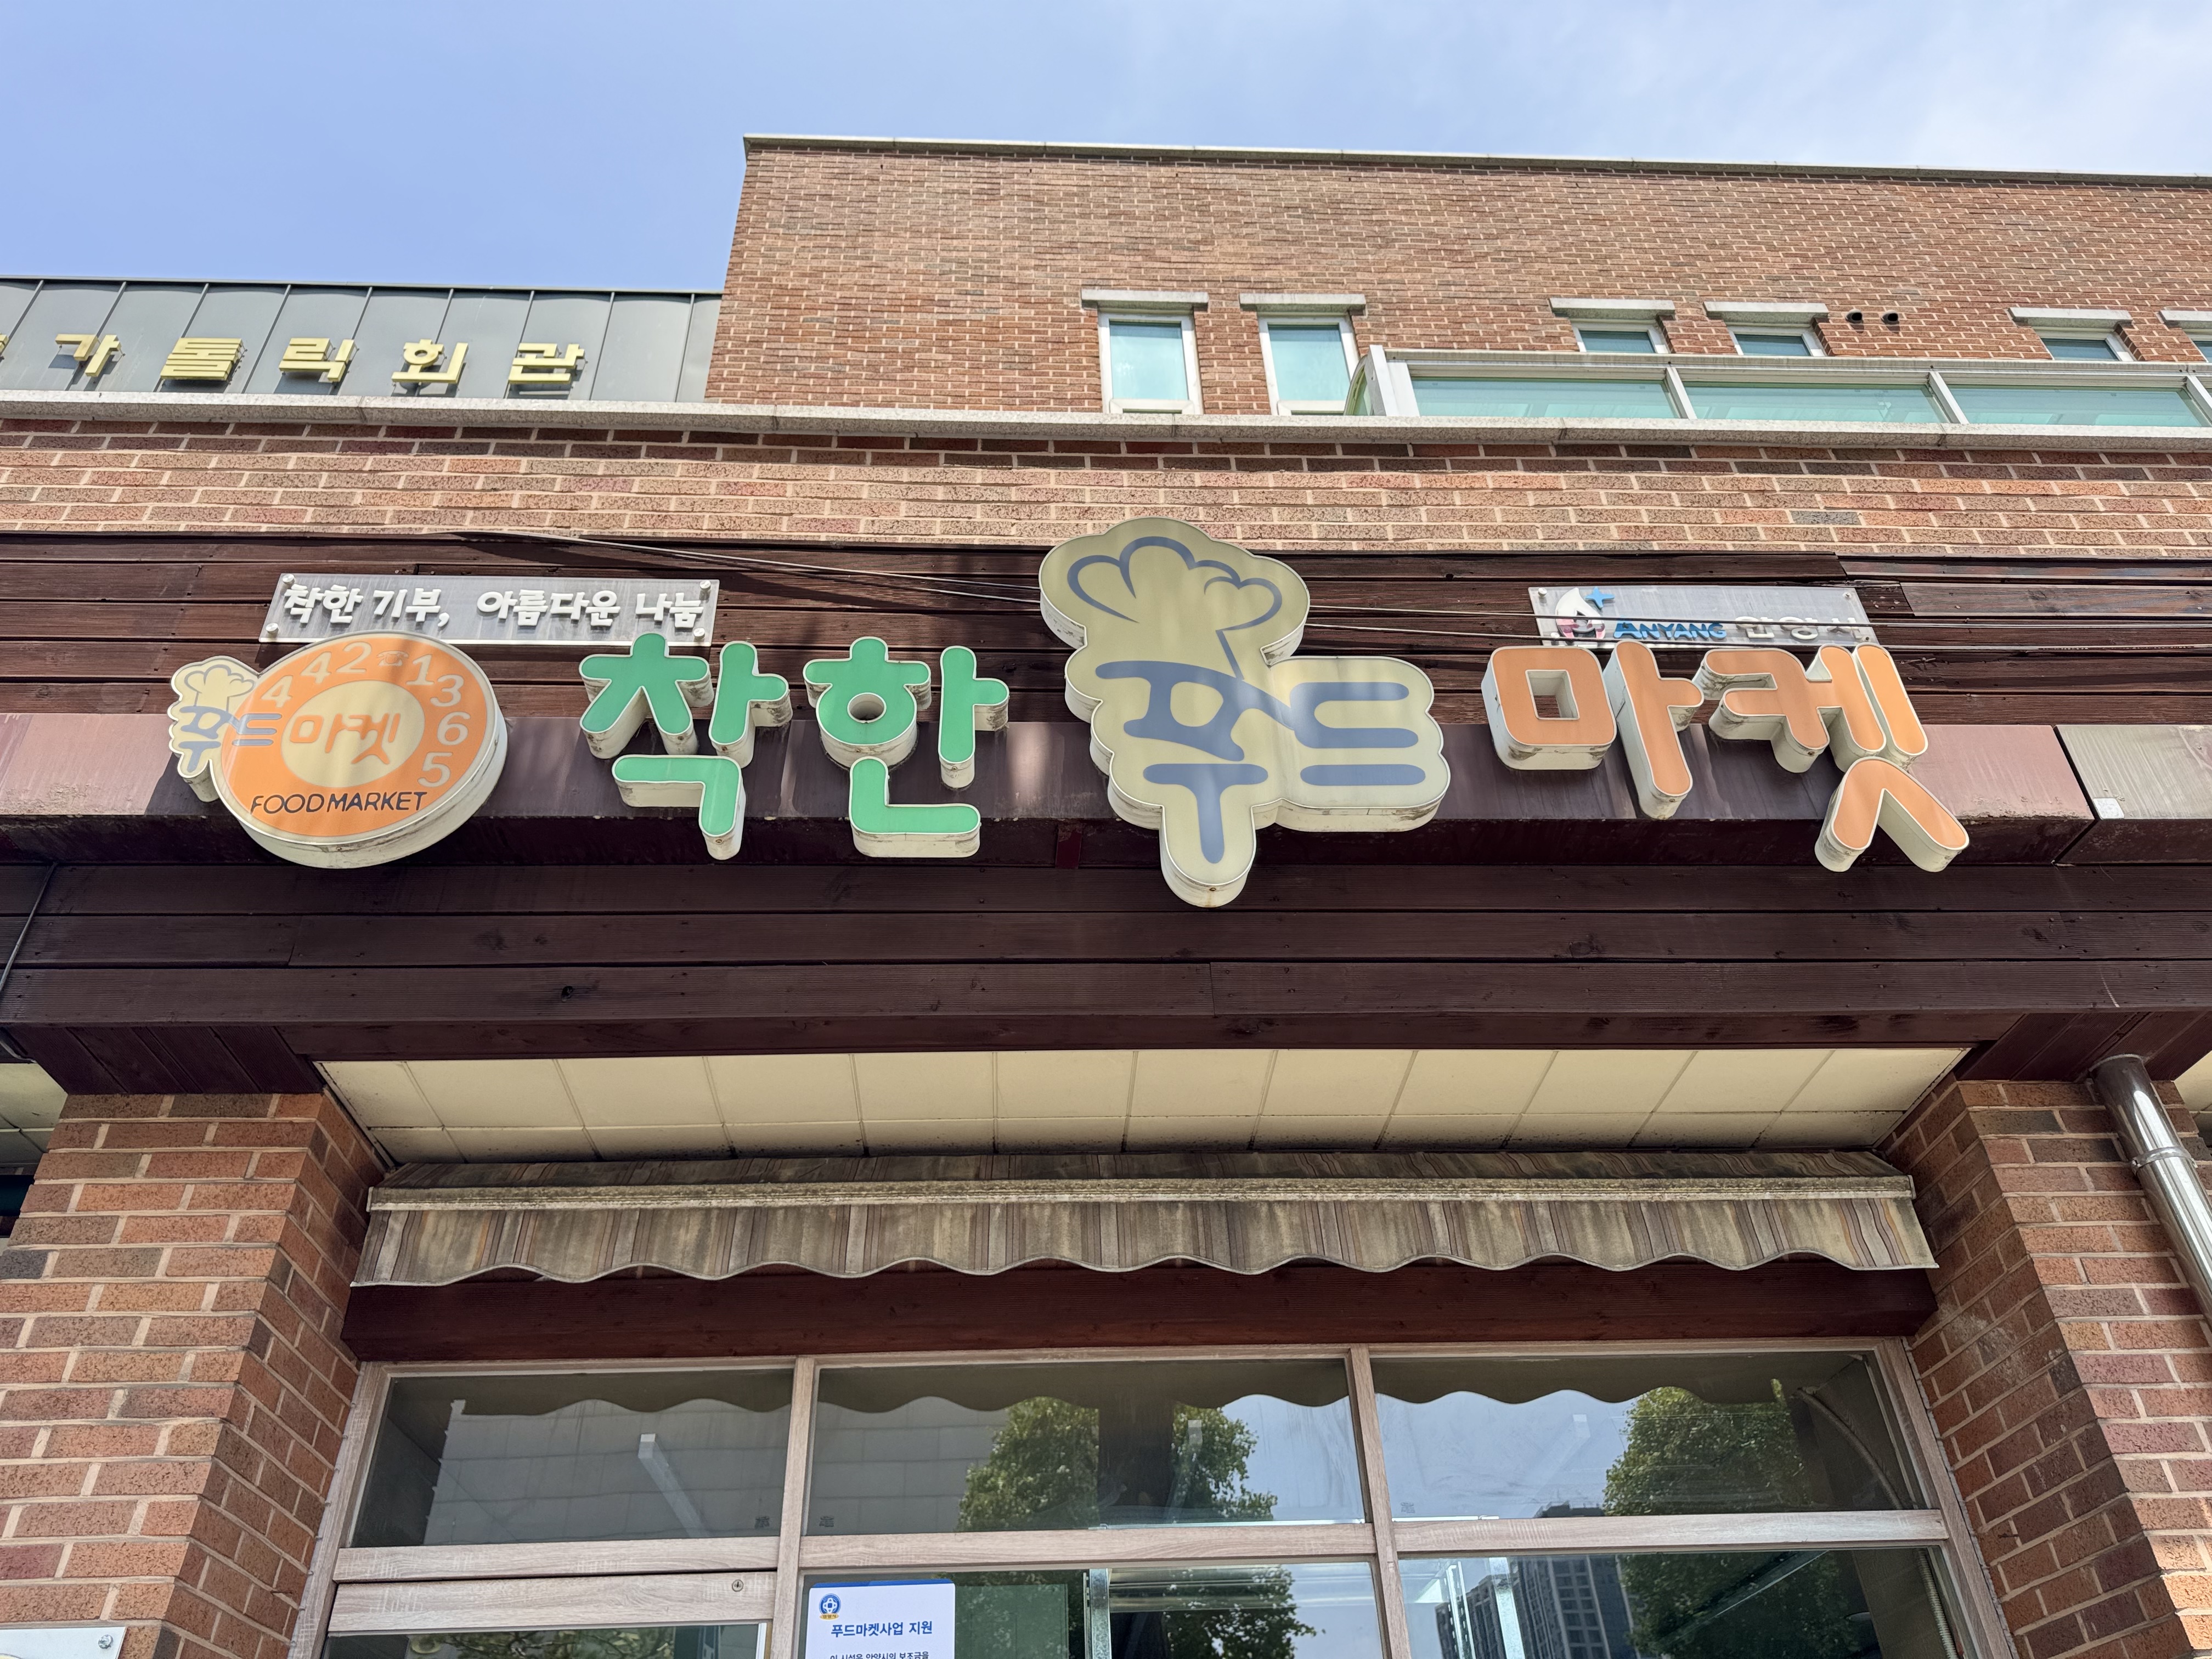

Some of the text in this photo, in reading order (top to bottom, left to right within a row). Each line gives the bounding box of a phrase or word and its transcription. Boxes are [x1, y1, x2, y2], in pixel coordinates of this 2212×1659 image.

[284, 584, 704, 629] 착한 기부, 아름다운 나눔
[1613, 619, 1728, 641] ANYANG
[1735, 616, 1863, 640] 안양시
[579, 633, 1011, 849] 착한
[831, 1620, 933, 1638] 푸드마켓사업 지원
